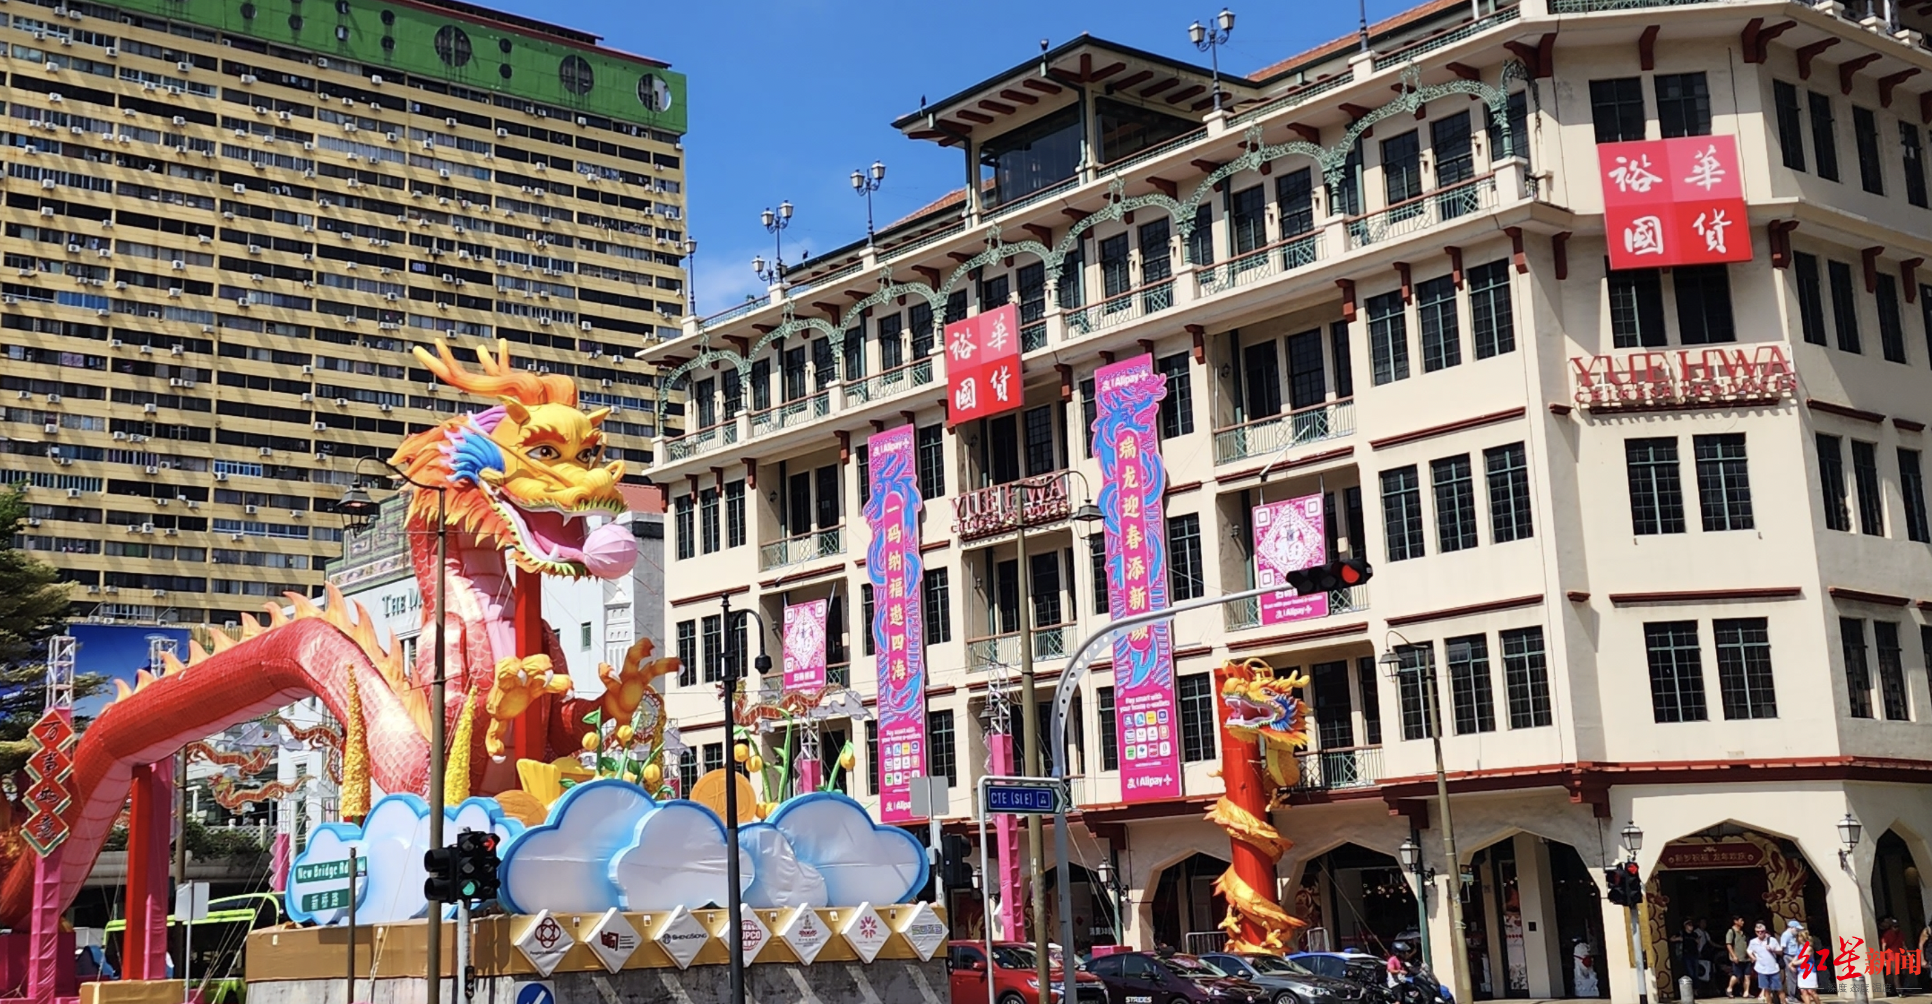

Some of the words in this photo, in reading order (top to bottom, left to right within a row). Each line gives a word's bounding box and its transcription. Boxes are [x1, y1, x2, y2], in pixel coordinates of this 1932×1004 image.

[1608, 144, 1726, 192] 裕華
[1624, 208, 1733, 255] 國貨
[949, 313, 1009, 361] 裕華
[1570, 352, 1670, 387] YUE
[1677, 345, 1795, 382] HWA
[955, 365, 1012, 411] 國貨
[1574, 383, 1672, 403] CHINESE
[1680, 378, 1798, 398] PRODUCTS
[949, 486, 1000, 521] YUE
[382, 594, 407, 618] THE
[1140, 774, 1173, 788] Alipay+
[991, 792, 1007, 804] CTE
[1010, 792, 1033, 806] (SLE)
[298, 866, 313, 880] New
[314, 863, 338, 878] Bridge
[339, 861, 349, 875] Rd
